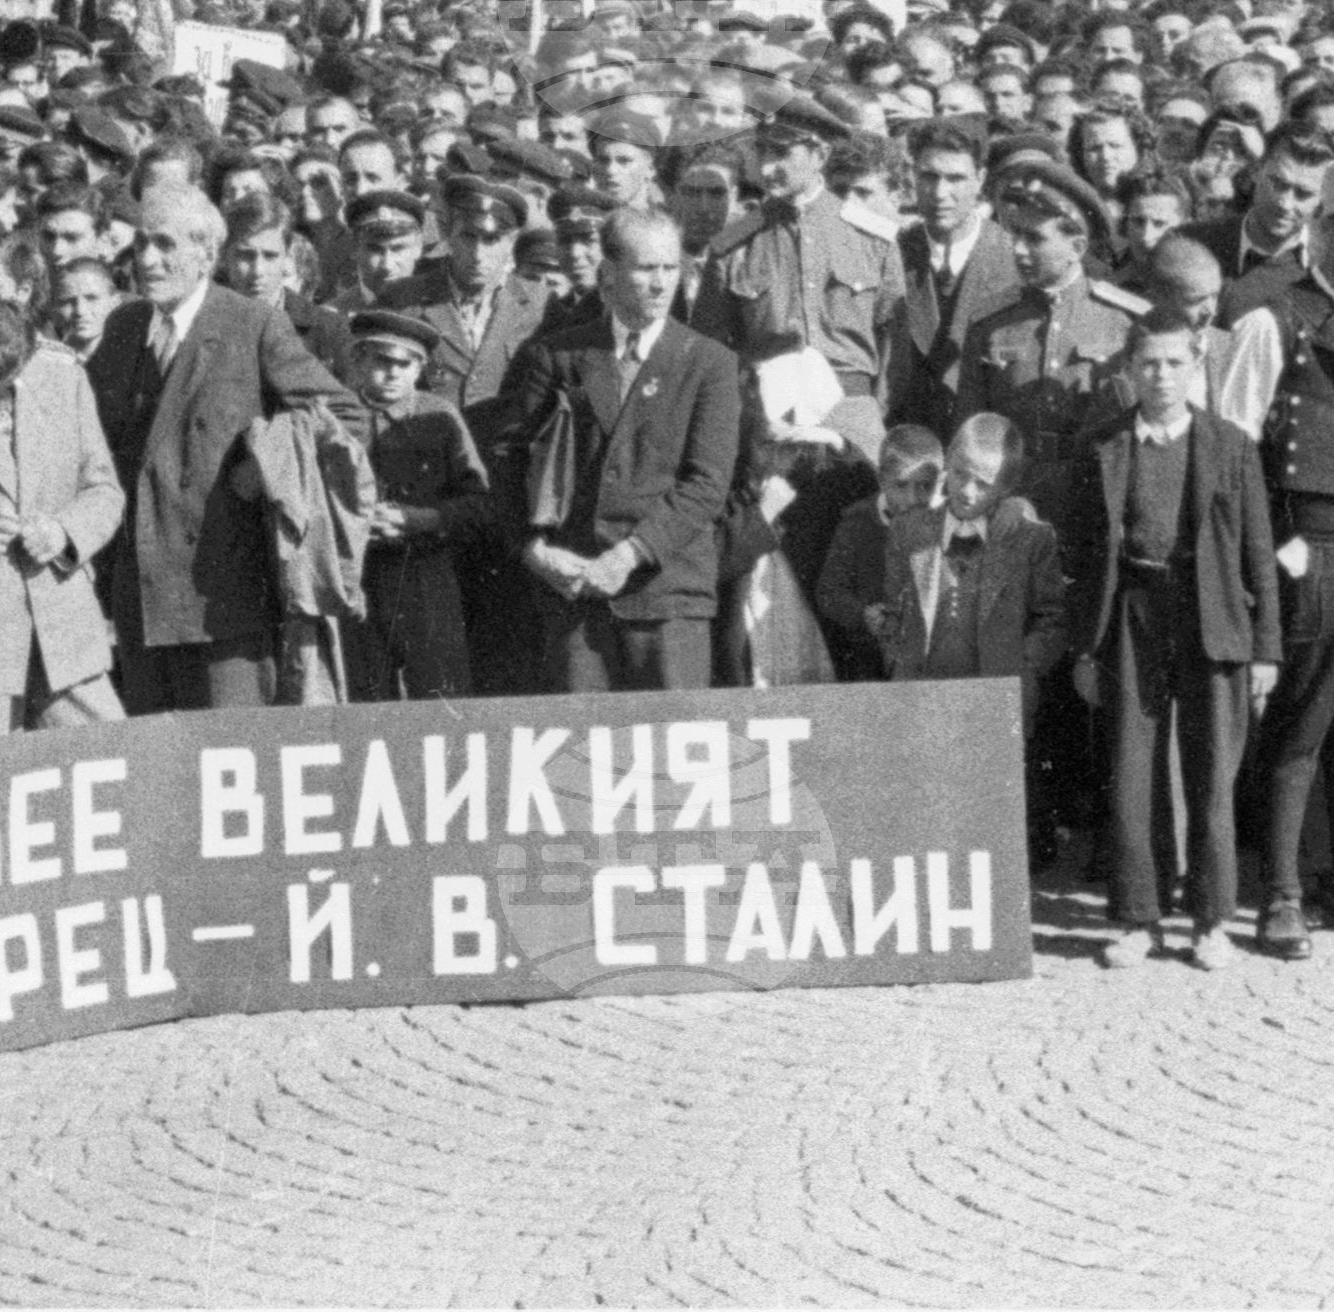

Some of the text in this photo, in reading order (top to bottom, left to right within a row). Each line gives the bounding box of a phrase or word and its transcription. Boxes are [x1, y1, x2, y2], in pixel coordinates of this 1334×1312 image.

[199, 717, 811, 860] ВЕЛИКИЯТ
[432, 874, 521, 976] В.
[592, 849, 993, 968] СТАЛИН
